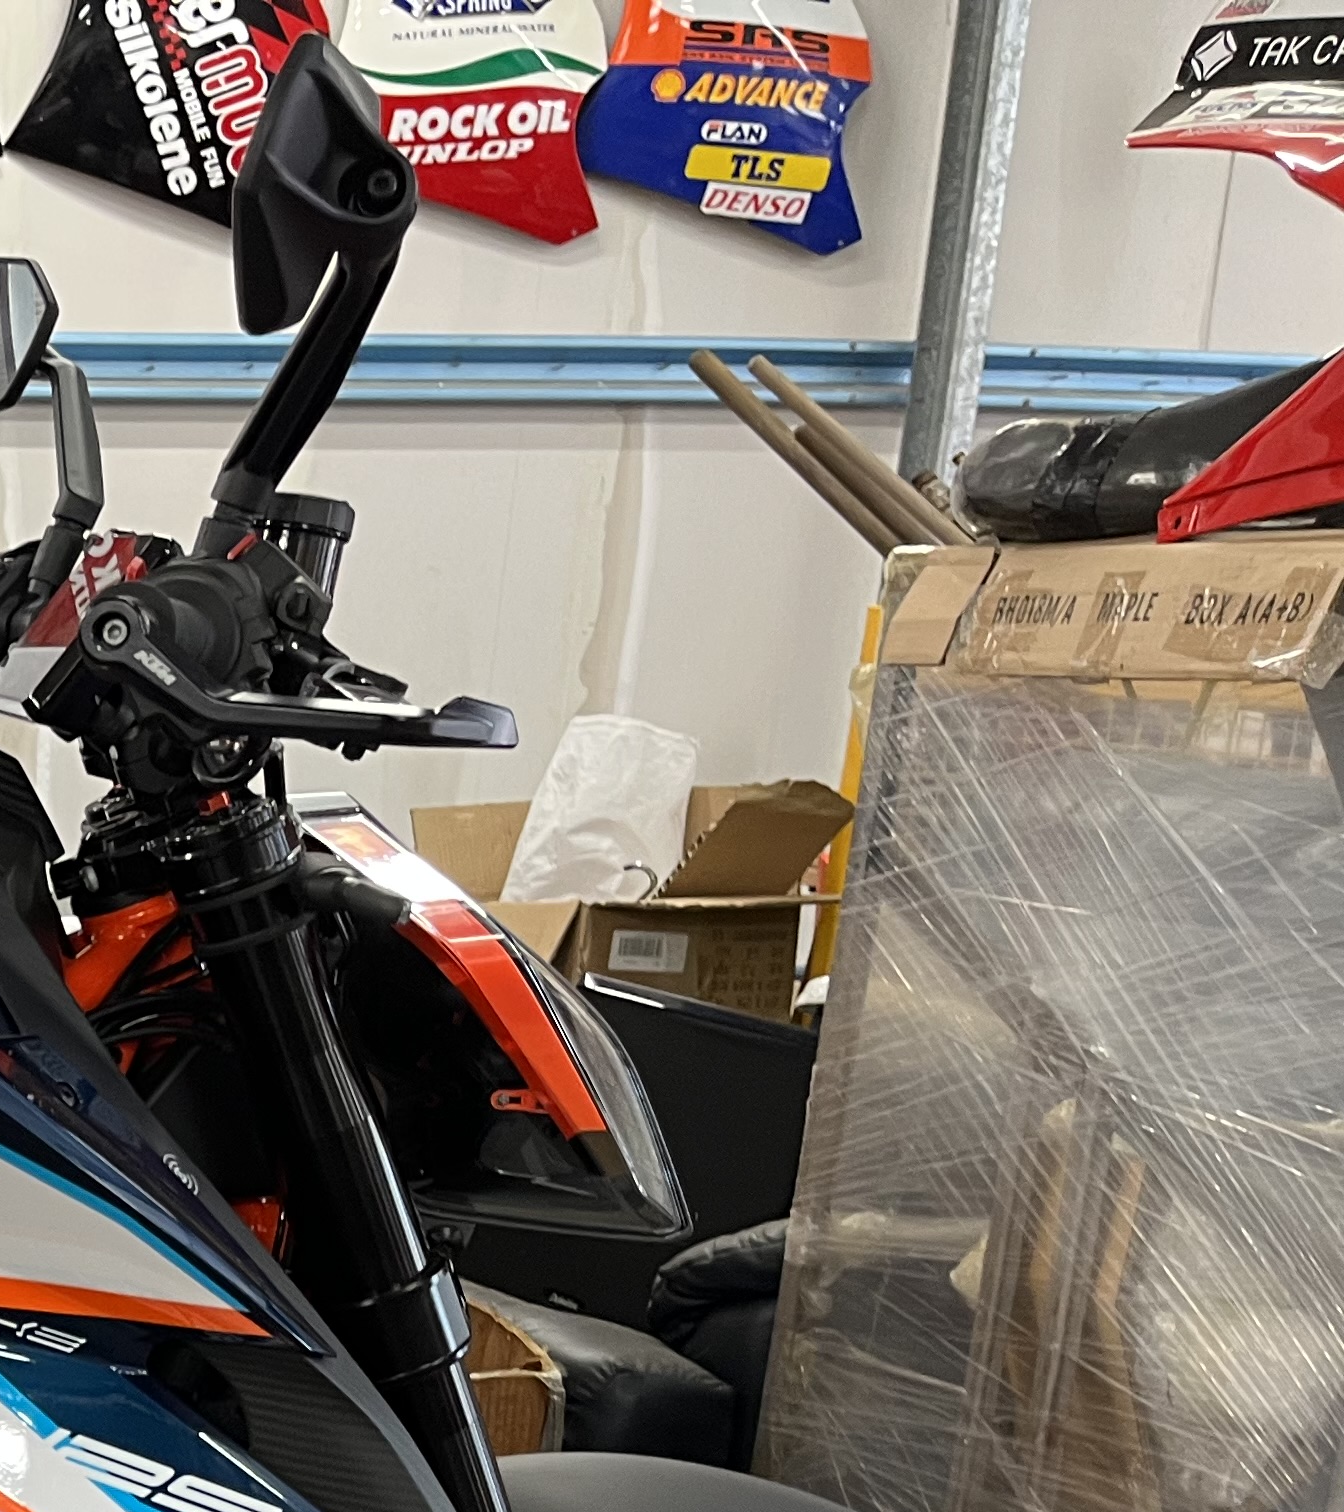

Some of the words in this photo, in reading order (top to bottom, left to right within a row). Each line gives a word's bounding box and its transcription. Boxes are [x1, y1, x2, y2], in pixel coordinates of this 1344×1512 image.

[1248, 35, 1311, 67] TAK
[684, 72, 831, 114] ADVANCE
[173, 67, 212, 143] MOBILE
[200, 146, 226, 189] FUN
[388, 102, 505, 143] ROCK
[507, 99, 571, 137] OIL
[731, 154, 785, 182] TLS
[704, 188, 806, 219] DENSO
[1097, 592, 1159, 624] MAPLE
[1185, 592, 1233, 625] BOX
